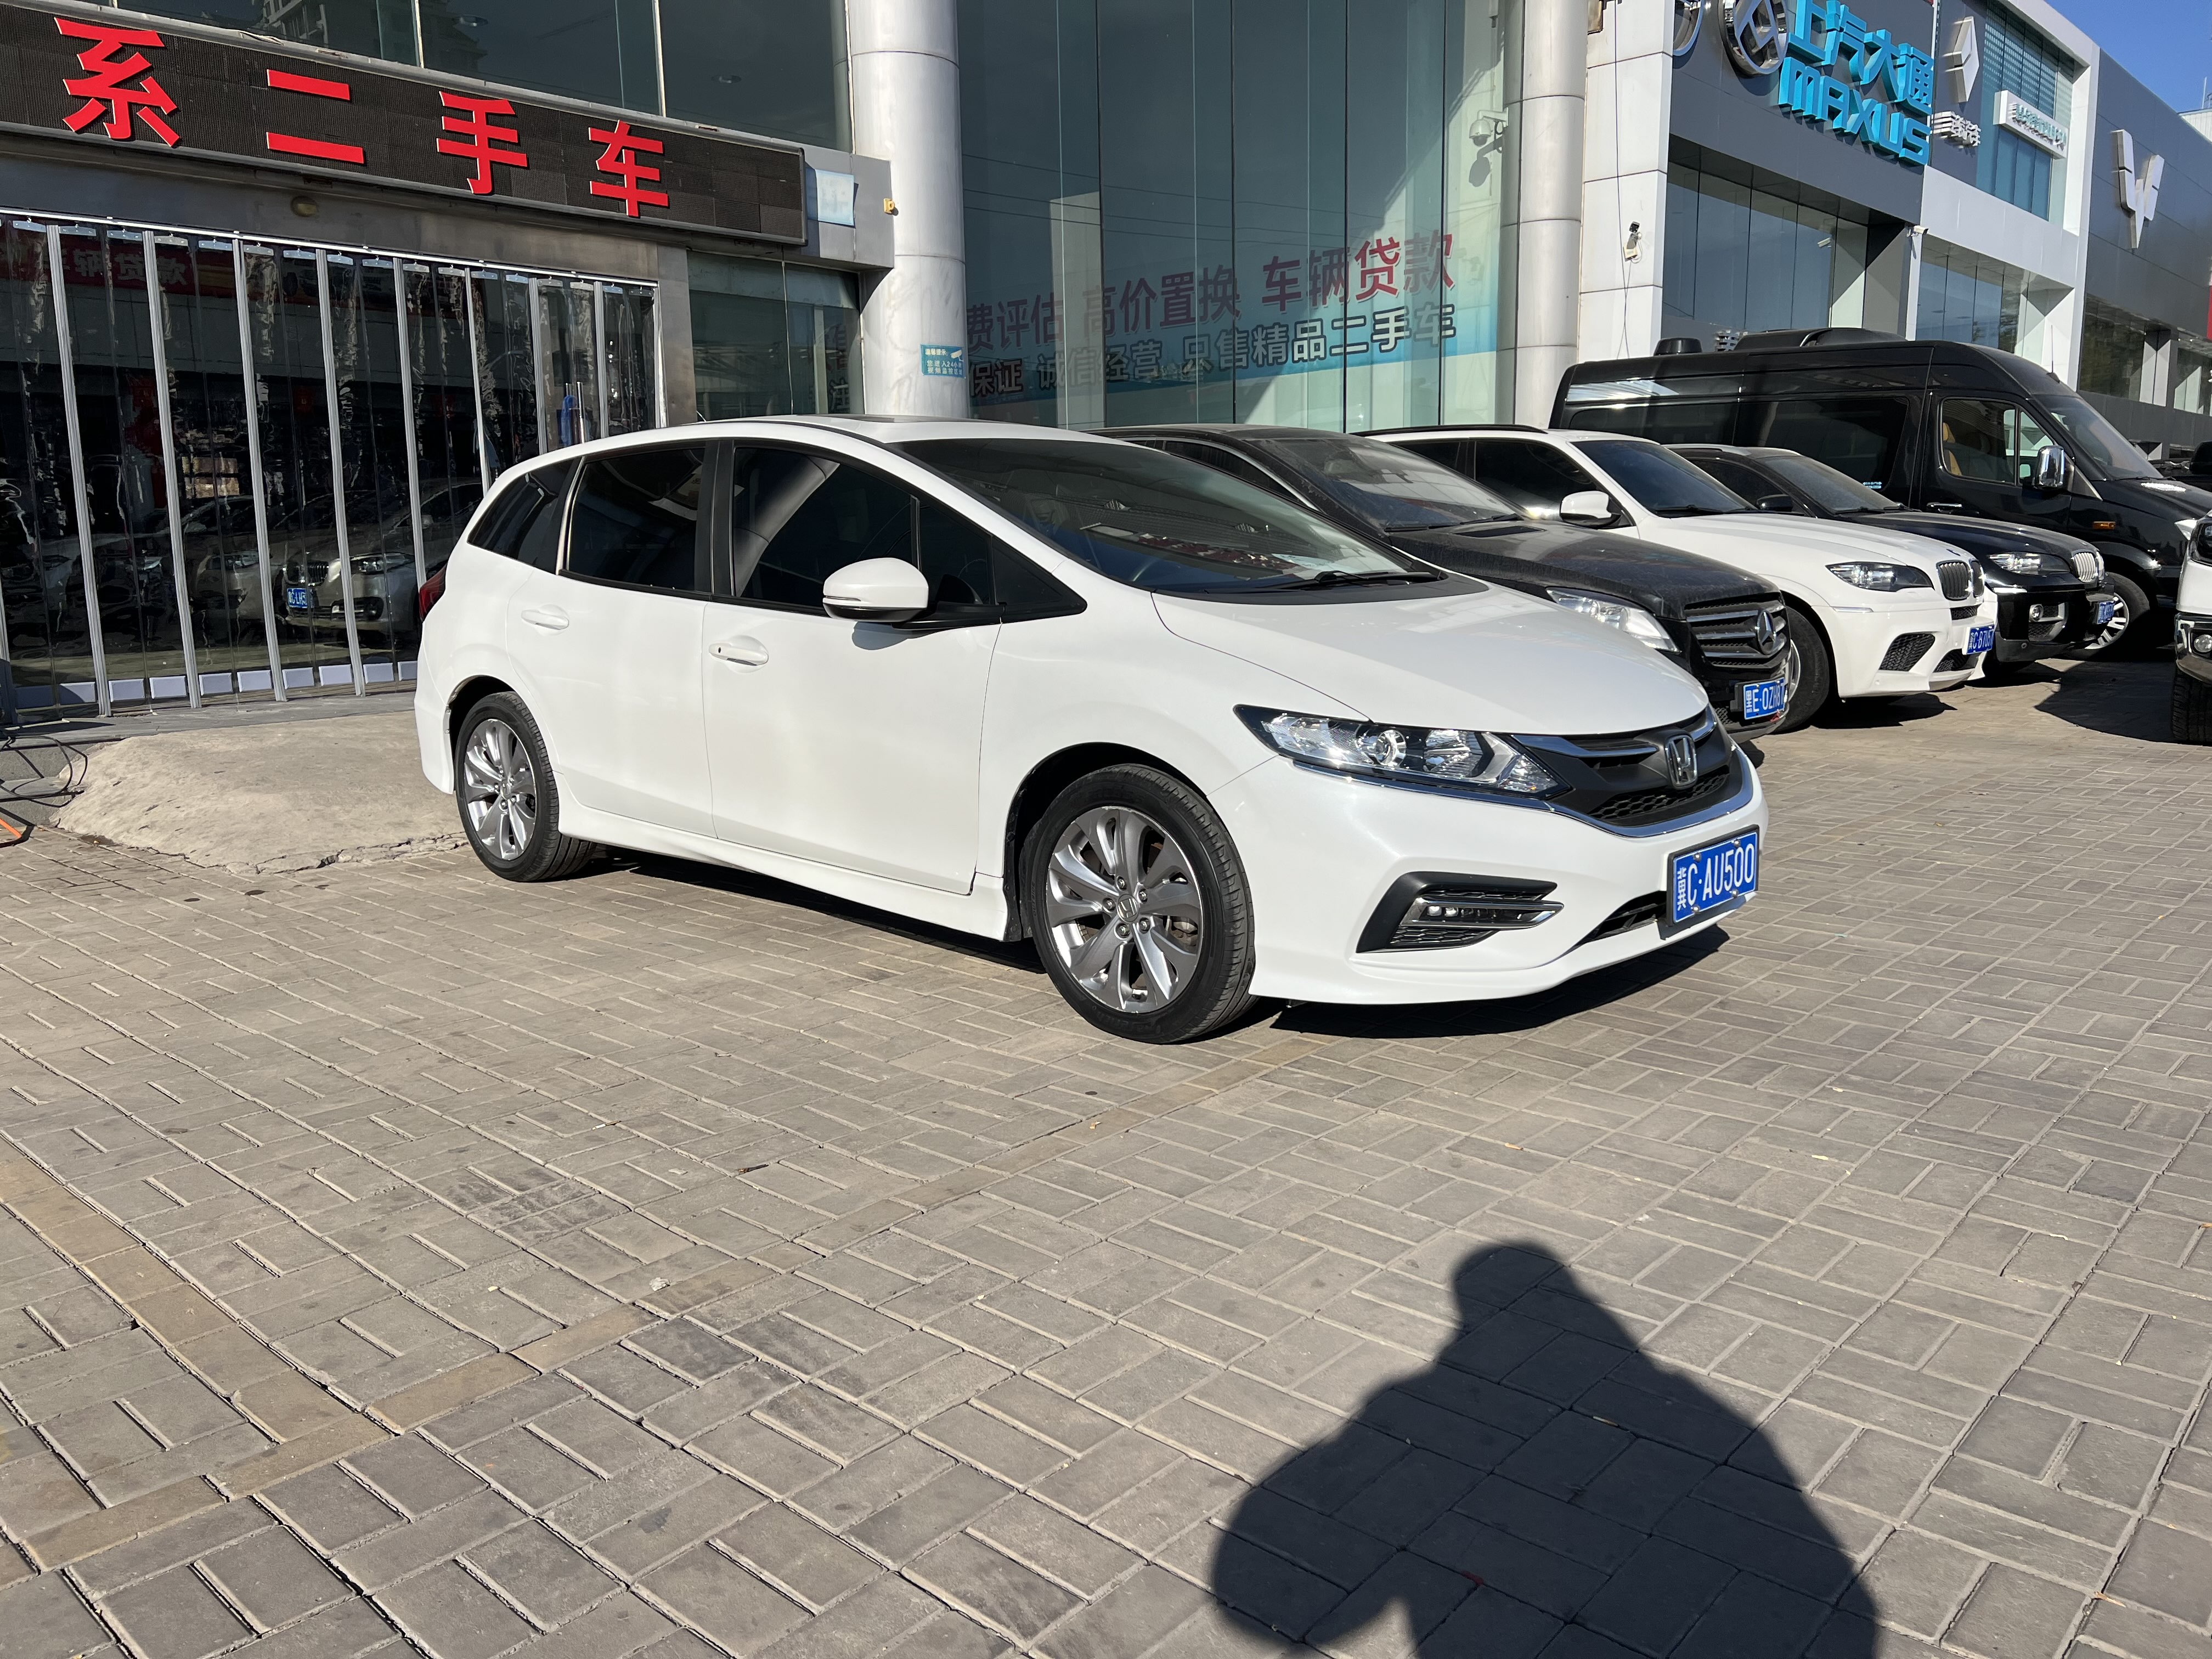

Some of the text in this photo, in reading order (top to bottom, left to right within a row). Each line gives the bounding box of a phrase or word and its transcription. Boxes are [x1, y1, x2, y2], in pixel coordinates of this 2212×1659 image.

[1779, 57, 1931, 165] MAXUS
[1083, 264, 1242, 336] 高价置换
[1262, 229, 1454, 313] 车辆贷款
[1037, 339, 1162, 391] 诚信经营
[1183, 302, 1456, 374] 只售精品二手车
